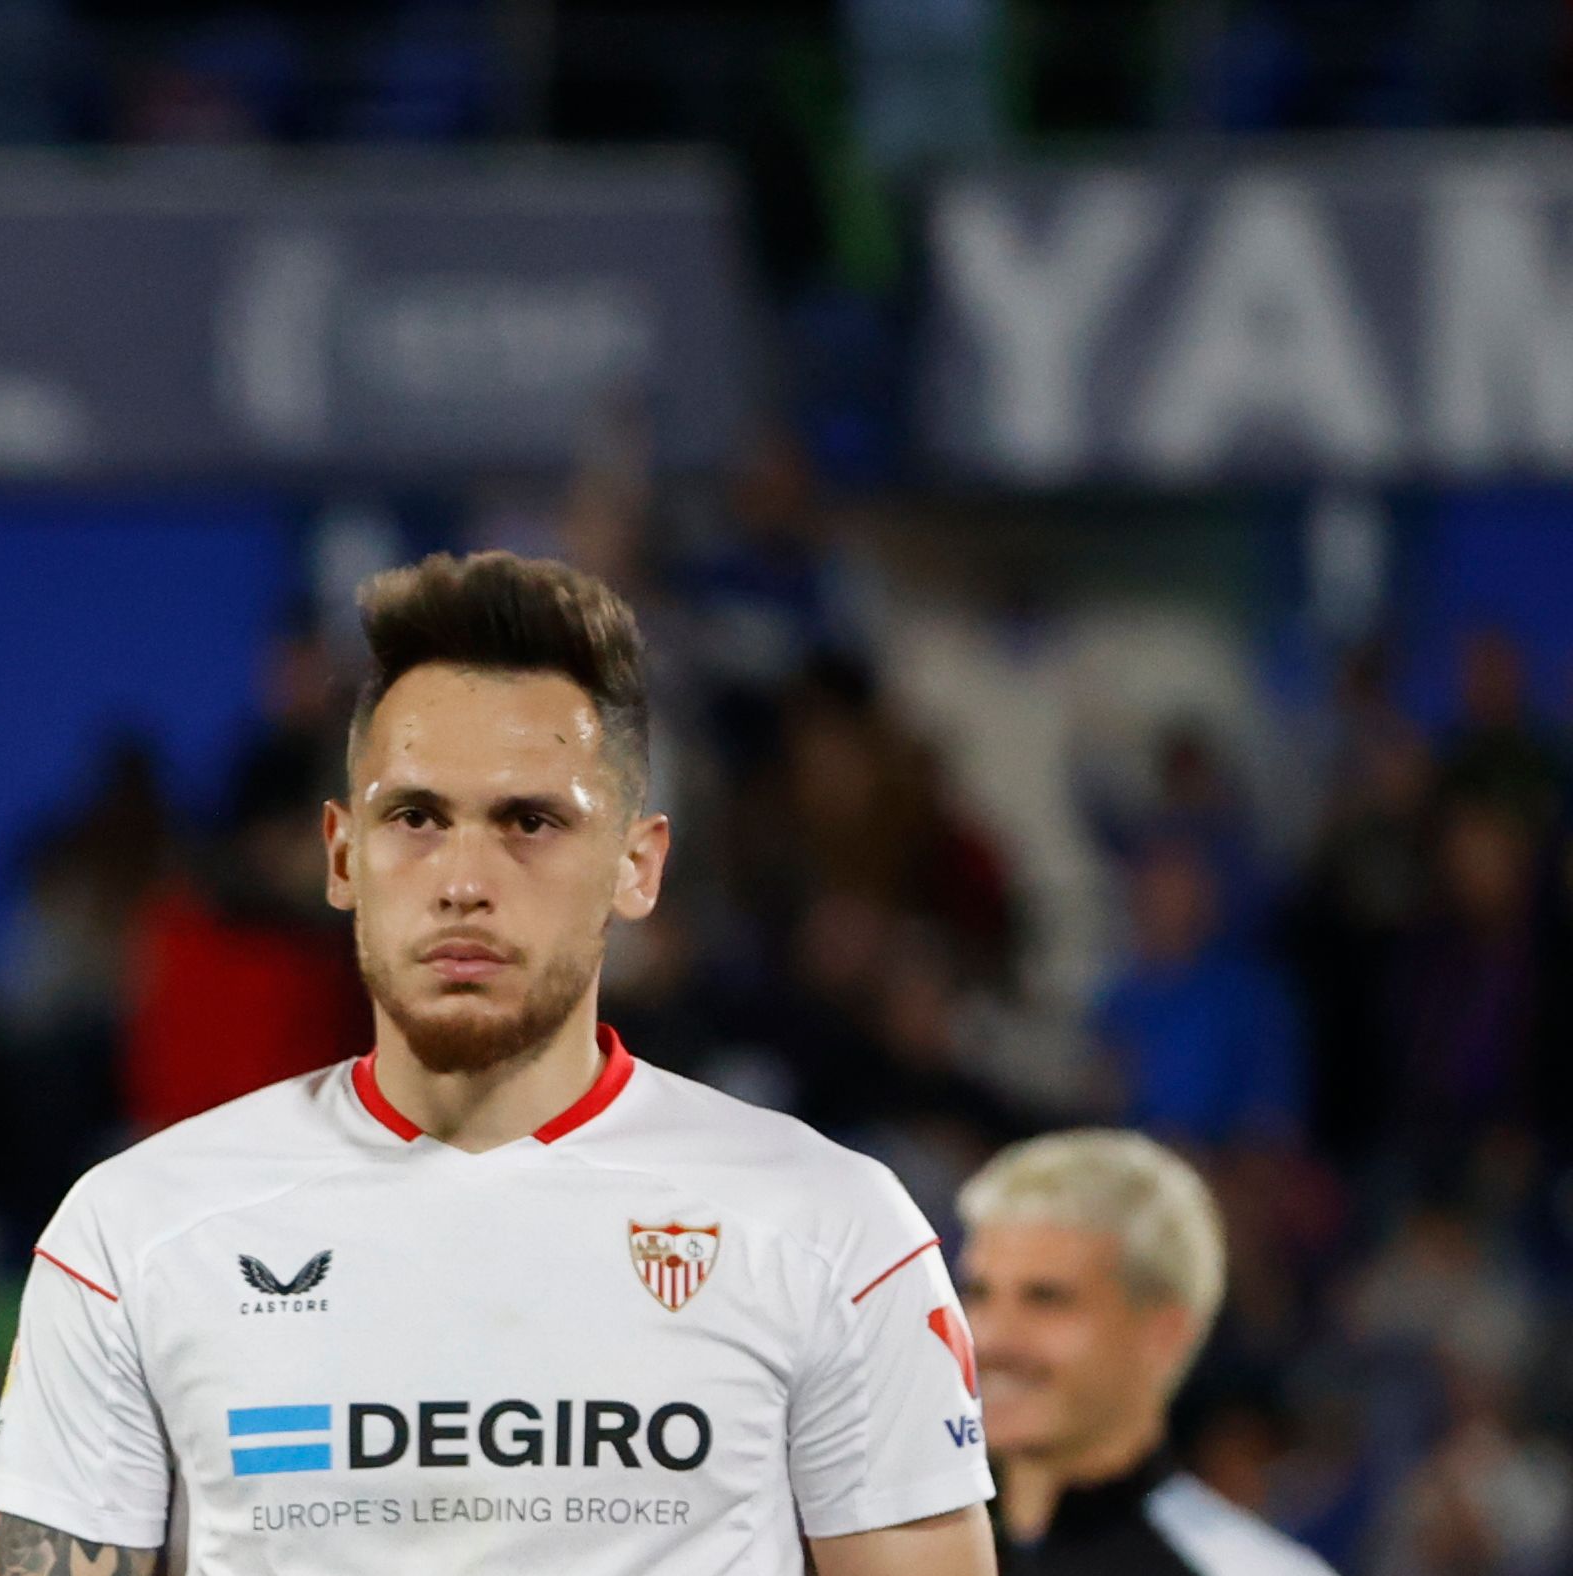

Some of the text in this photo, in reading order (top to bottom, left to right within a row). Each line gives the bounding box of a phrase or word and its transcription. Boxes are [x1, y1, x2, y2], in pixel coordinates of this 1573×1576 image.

[240, 1299, 328, 1315] CASTORE
[349, 1398, 712, 1471] DEGIRO
[253, 1497, 690, 1532] EUROPE'S LEADING BROKER
